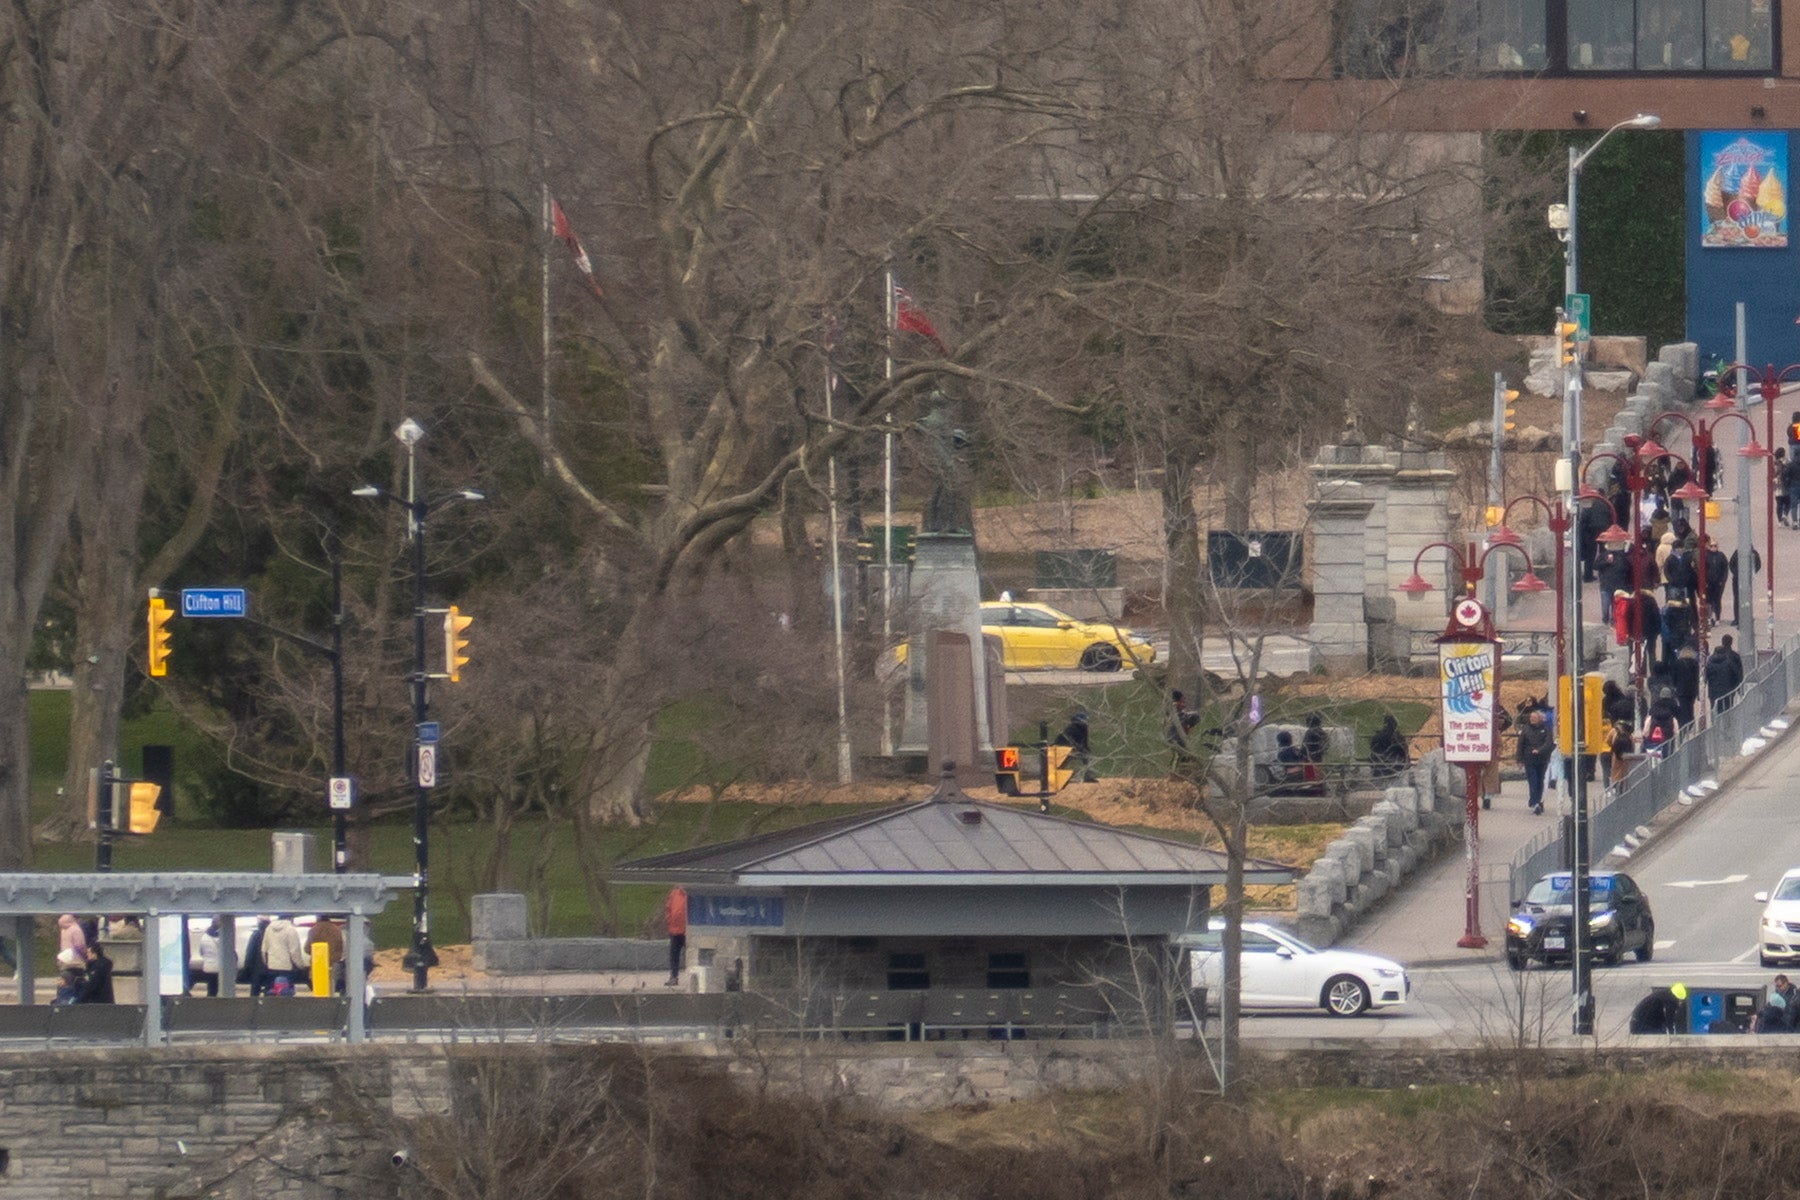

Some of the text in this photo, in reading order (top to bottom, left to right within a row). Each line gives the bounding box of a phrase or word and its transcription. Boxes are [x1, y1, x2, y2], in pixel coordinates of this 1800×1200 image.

[185, 594, 241, 611] Clifton Hill
[1443, 654, 1491, 678] Clifton
[1459, 672, 1485, 693] Hill
